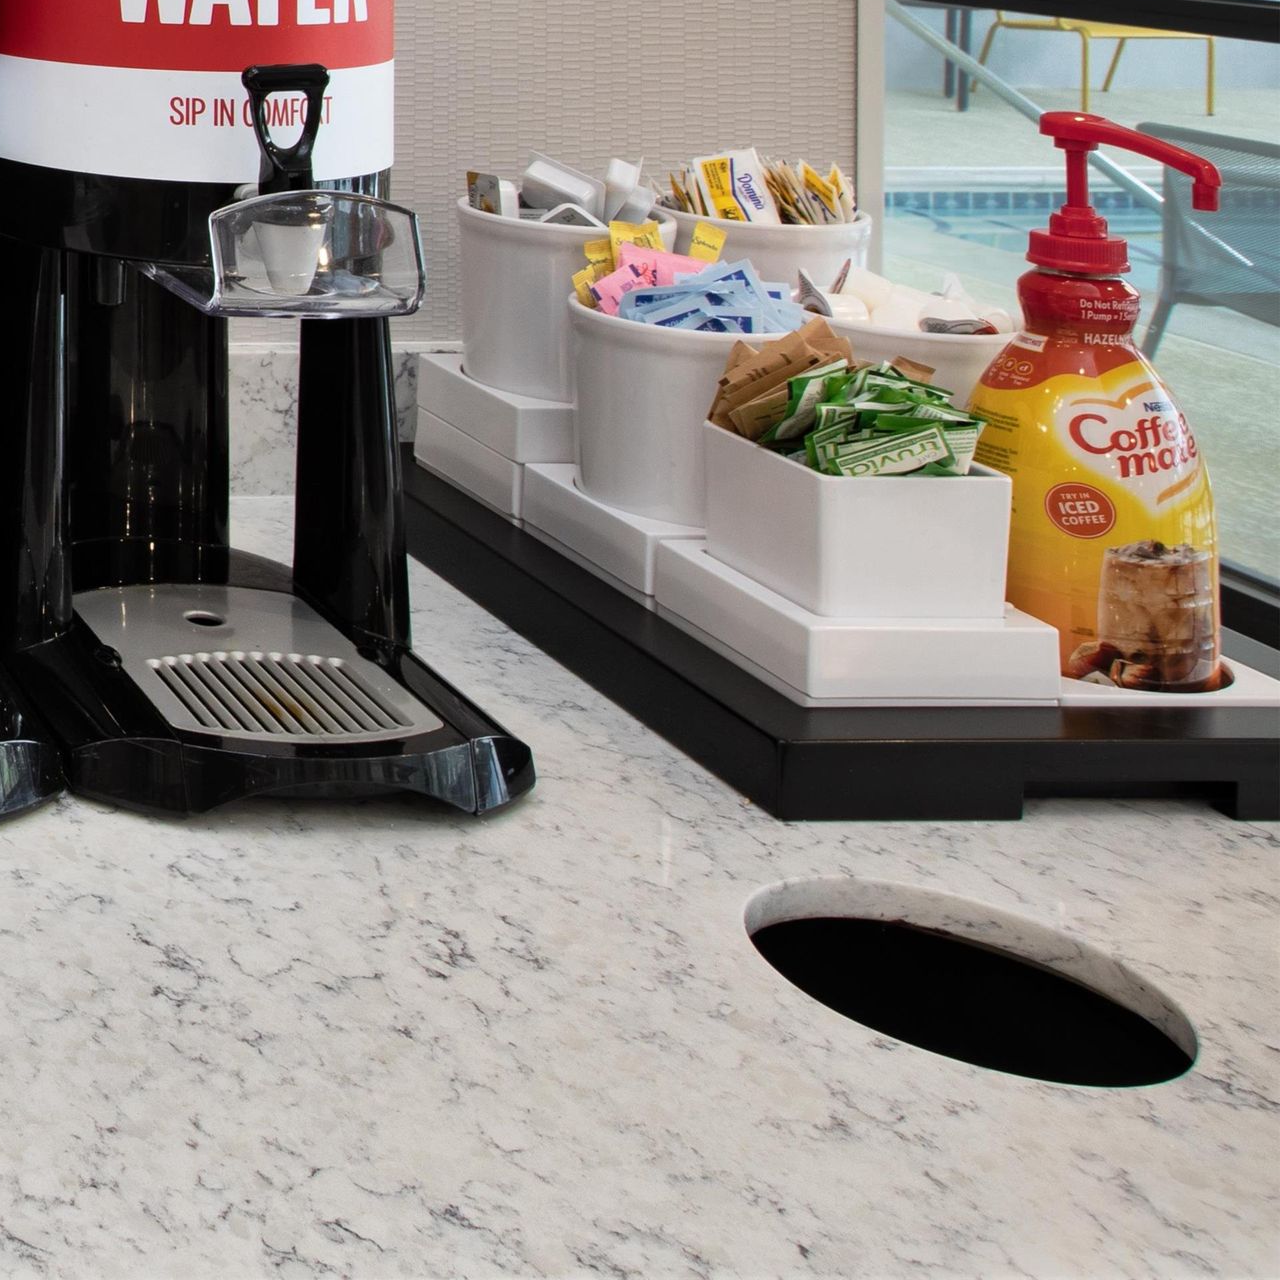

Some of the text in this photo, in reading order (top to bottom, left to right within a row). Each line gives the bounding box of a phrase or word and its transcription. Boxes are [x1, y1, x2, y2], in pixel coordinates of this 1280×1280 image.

[169, 96, 333, 127] SIP IN COMFOT
[736, 173, 764, 210] Domino
[1080, 299, 1092, 308] Do
[1095, 300, 1110, 309] Not
[1087, 311, 1112, 322] Pump
[1069, 412, 1189, 455] Coffee
[1058, 501, 1100, 514] ICED
[1062, 515, 1107, 526] COFFEE
